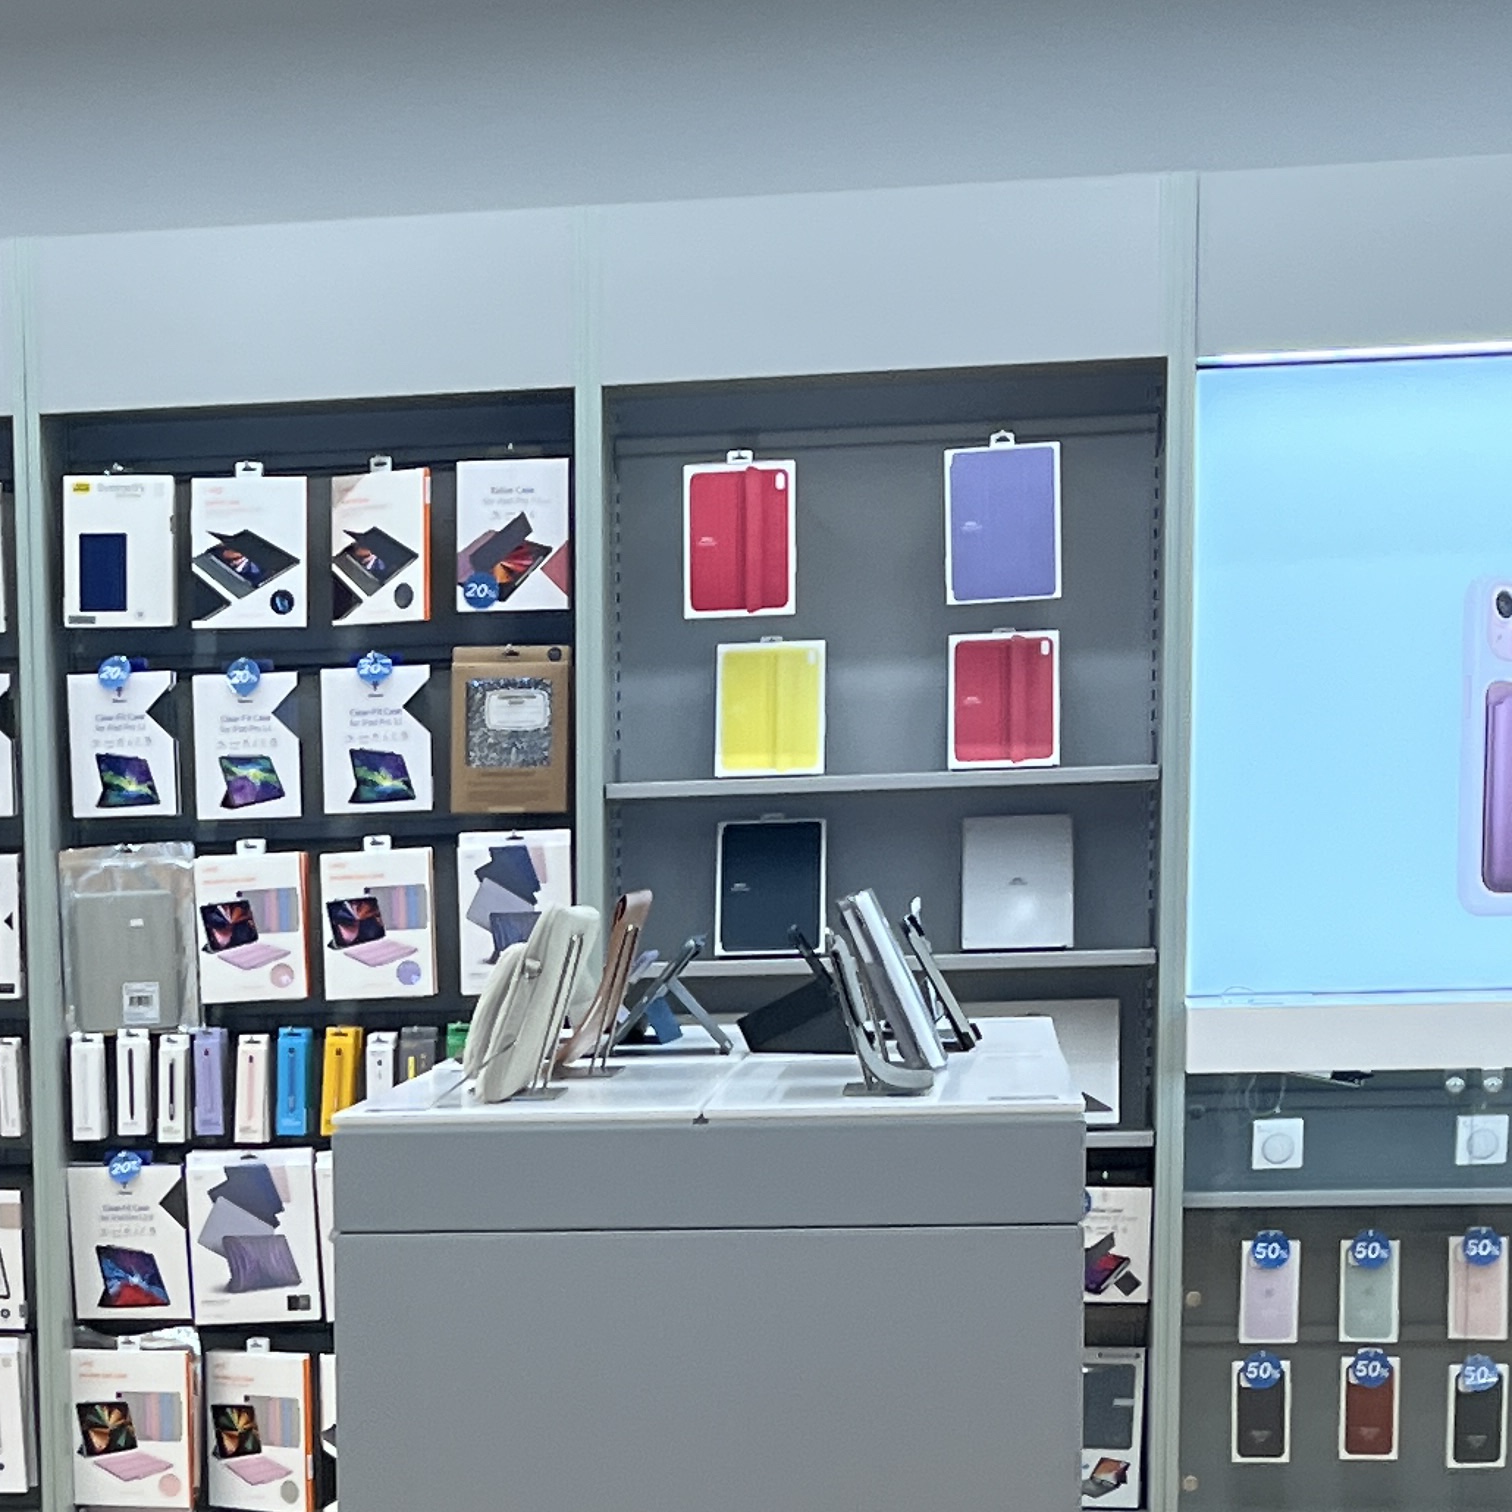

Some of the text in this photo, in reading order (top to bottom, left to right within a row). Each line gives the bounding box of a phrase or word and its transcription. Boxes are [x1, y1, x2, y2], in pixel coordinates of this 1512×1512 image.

[1254, 1242, 1288, 1259] 50%
[1353, 1242, 1388, 1259] 50%
[1466, 1240, 1500, 1256] 50%
[1245, 1361, 1281, 1379] 50%
[1355, 1360, 1390, 1378] 50%
